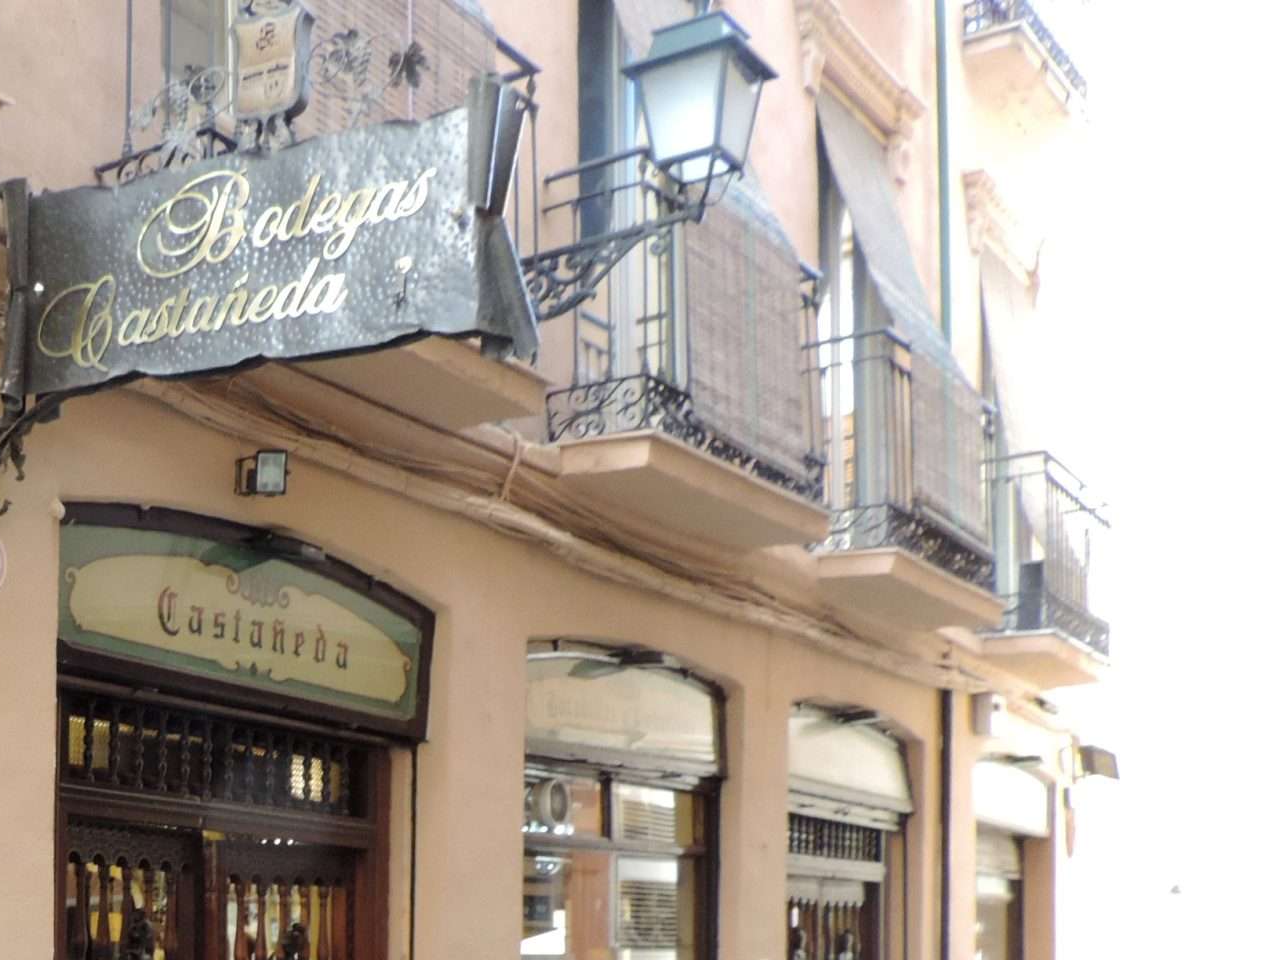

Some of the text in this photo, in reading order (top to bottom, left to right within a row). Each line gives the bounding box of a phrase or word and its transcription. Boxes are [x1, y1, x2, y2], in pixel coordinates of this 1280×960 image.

[136, 169, 435, 278] Bodegas
[37, 261, 347, 371] Castañeda
[158, 587, 350, 670] Castañeda
